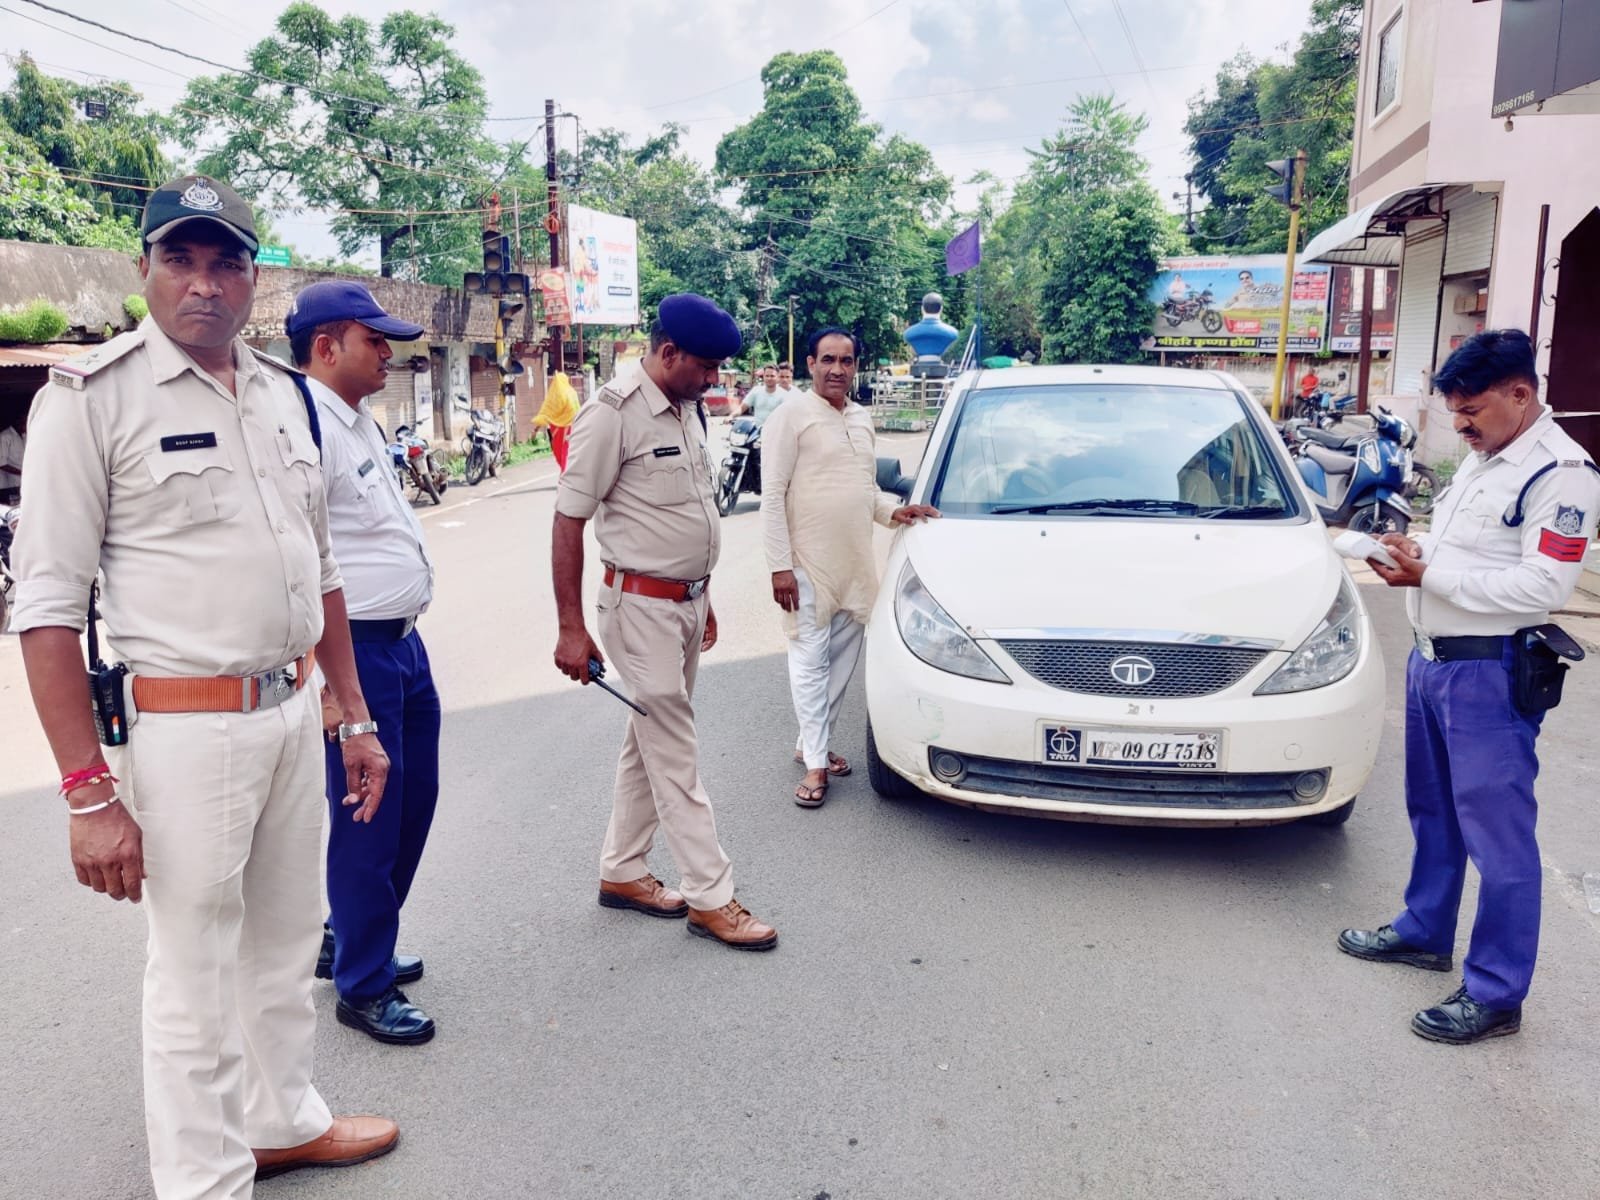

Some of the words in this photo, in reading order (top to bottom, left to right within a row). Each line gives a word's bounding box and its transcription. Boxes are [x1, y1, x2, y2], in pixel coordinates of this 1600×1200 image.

[1049, 753, 1077, 761] TATA
[1122, 741, 1143, 760] 09
[1148, 742, 1172, 760] CJ
[1175, 743, 1216, 761] 7518
